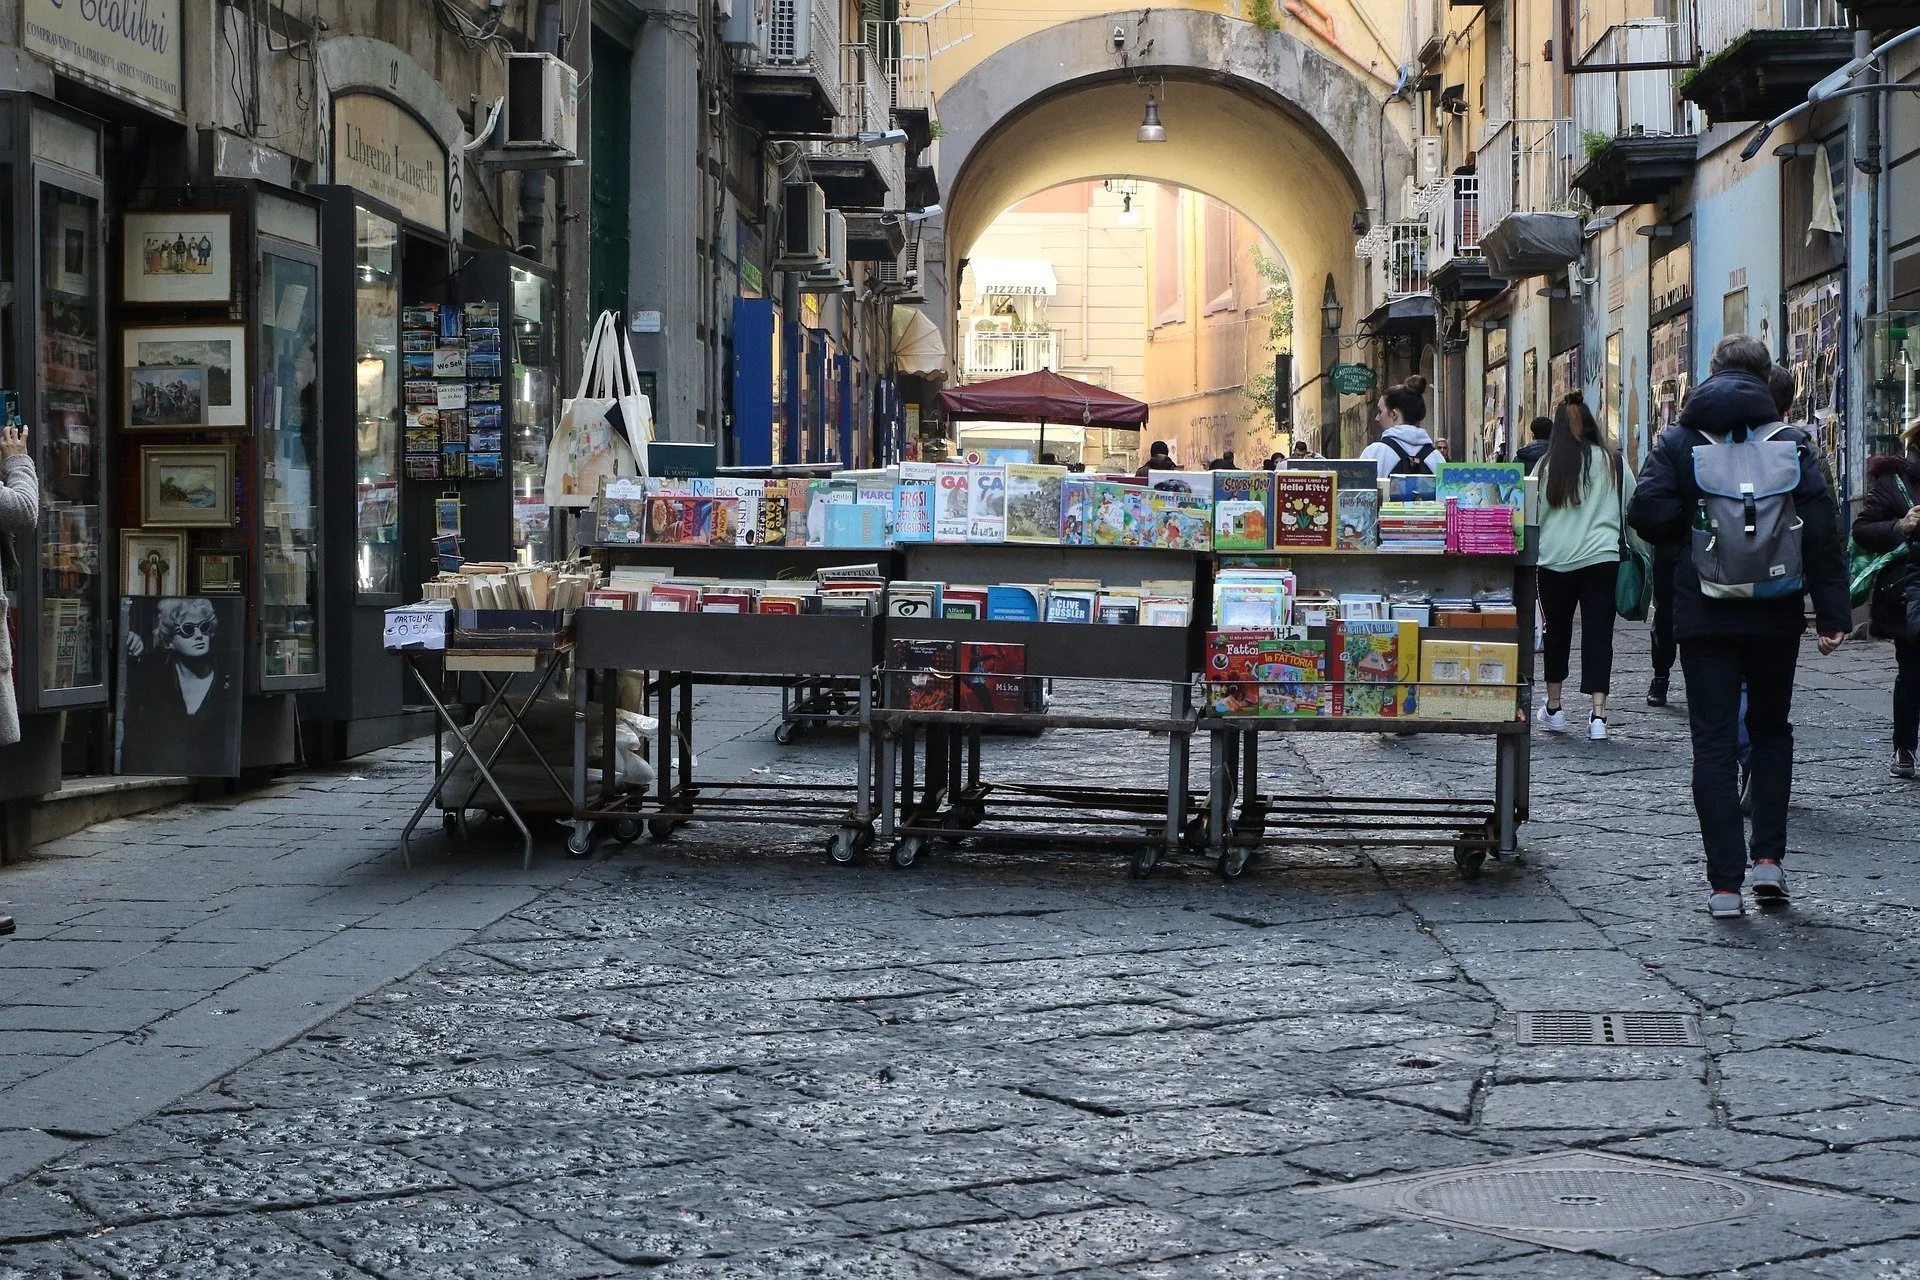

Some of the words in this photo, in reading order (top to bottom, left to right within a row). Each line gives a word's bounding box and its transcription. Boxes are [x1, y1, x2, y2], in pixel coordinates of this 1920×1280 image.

[27, 21, 81, 57] COMPRAVENTA
[82, 47, 99, 63] LIBRI
[390, 59, 398, 85] 10
[346, 123, 391, 176] Libreria
[394, 145, 439, 197] Langella
[985, 285, 1047, 294] PIZZERIA
[437, 361, 449, 370] We
[449, 359, 463, 368] Sell
[1280, 483, 1304, 491] Hello
[1305, 483, 1330, 493] Kitty
[760, 501, 766, 512] LA
[900, 490, 927, 508] FRASI
[683, 504, 692, 538] ARABA
[719, 508, 727, 533] CUCINA
[736, 500, 747, 542] CINESE
[895, 522, 930, 533] OCCASIONE
[758, 517, 766, 544] PIZZA
[1056, 600, 1080, 609] CLIVE
[1049, 608, 1085, 619] CUSSLER
[1264, 653, 1272, 661] la
[1274, 653, 1314, 668] FATTORIA
[995, 683, 1019, 692] Mika
